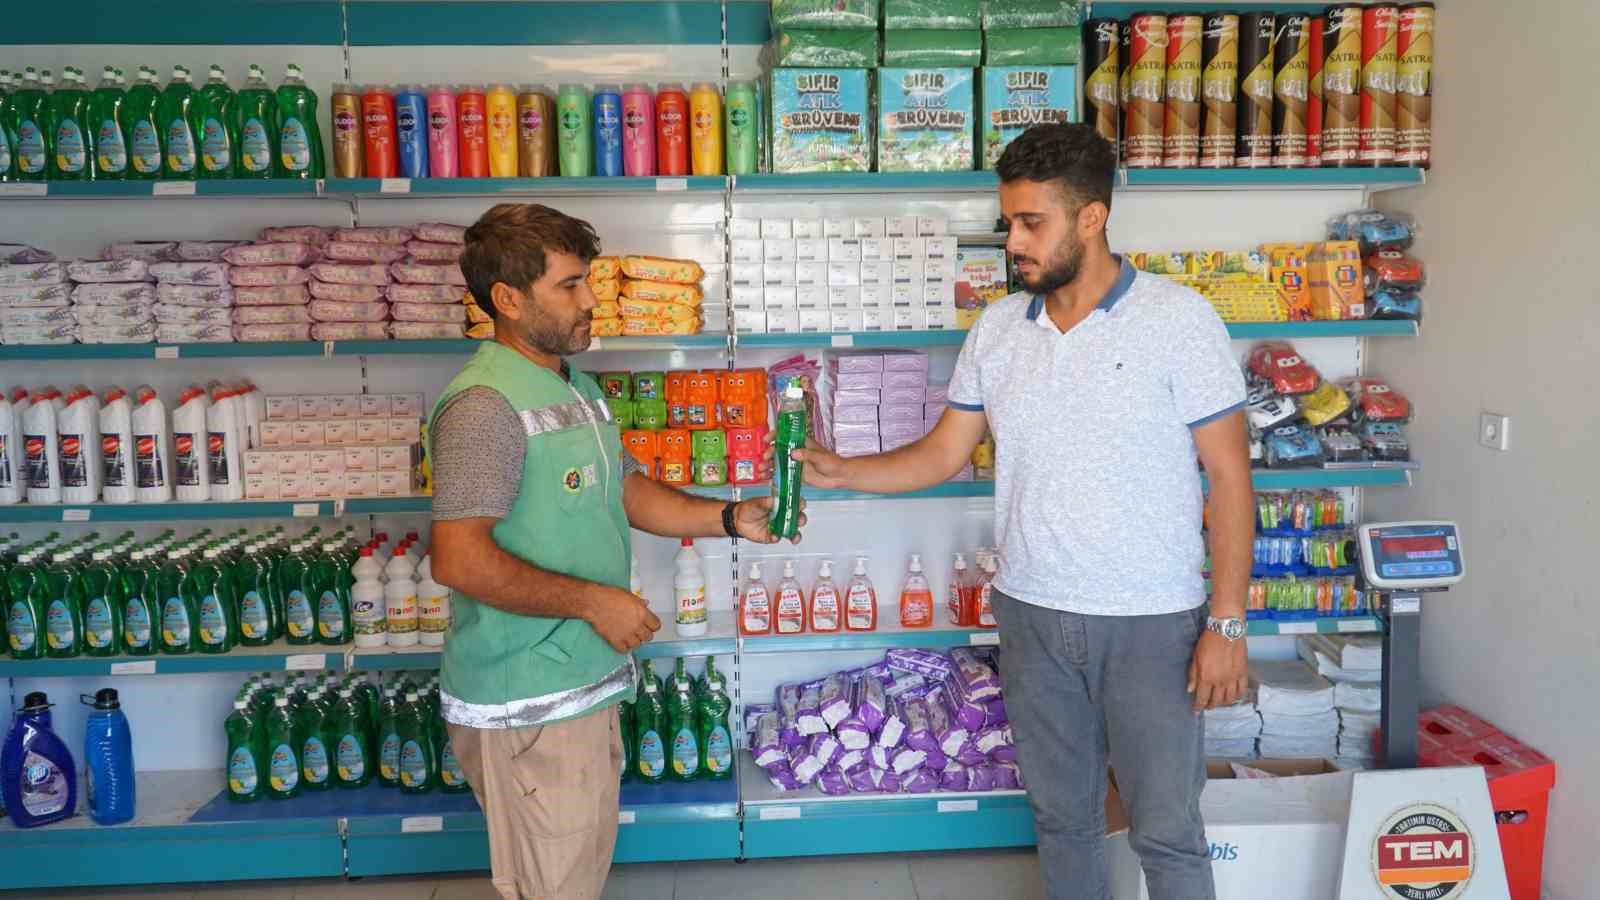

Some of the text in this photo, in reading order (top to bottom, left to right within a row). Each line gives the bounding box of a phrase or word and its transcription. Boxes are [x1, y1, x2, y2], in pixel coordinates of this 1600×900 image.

[798, 74, 840, 91] SIFIR
[903, 73, 945, 89] SIFIR
[1006, 71, 1049, 88] SIFIR
[1208, 842, 1239, 861] bis
[1385, 839, 1463, 861] TEM
